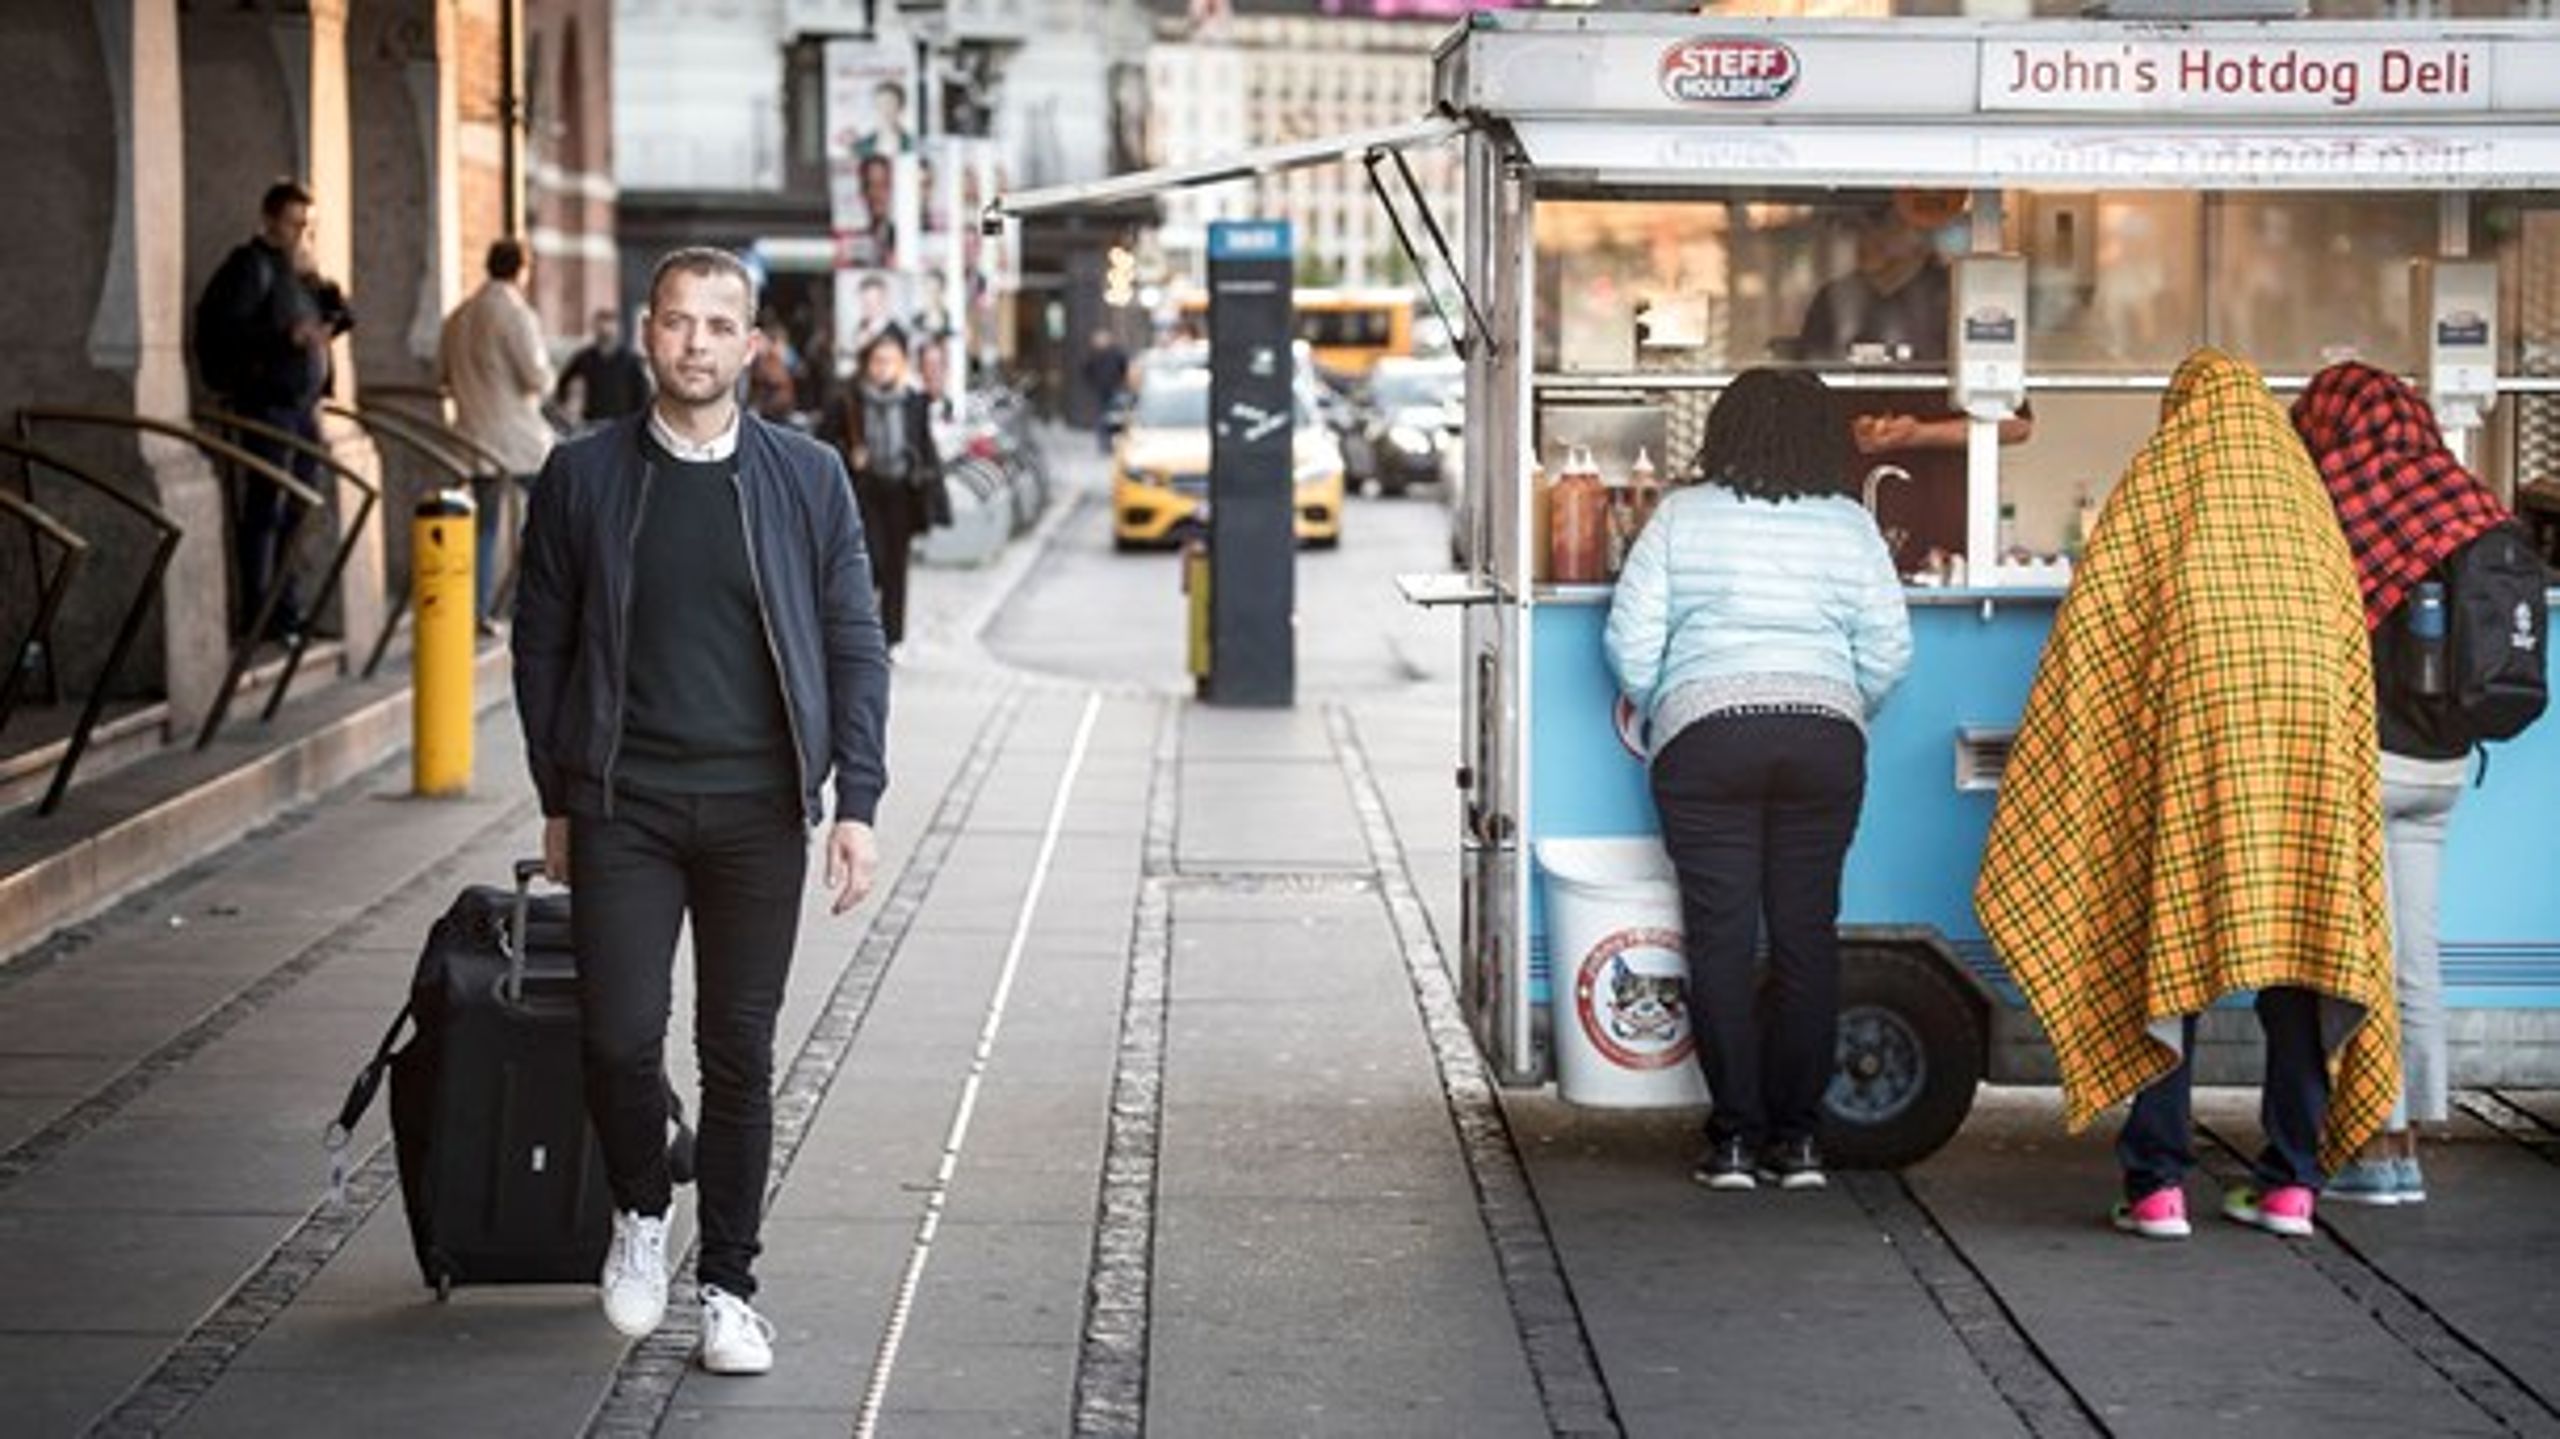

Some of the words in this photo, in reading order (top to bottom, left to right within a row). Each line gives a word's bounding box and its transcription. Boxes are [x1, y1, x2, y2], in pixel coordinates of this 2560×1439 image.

[1681, 50, 1779, 77] STEFF
[2009, 45, 2158, 93] John's
[2180, 49, 2359, 105] Hotdog
[2381, 49, 2469, 93] Deli
